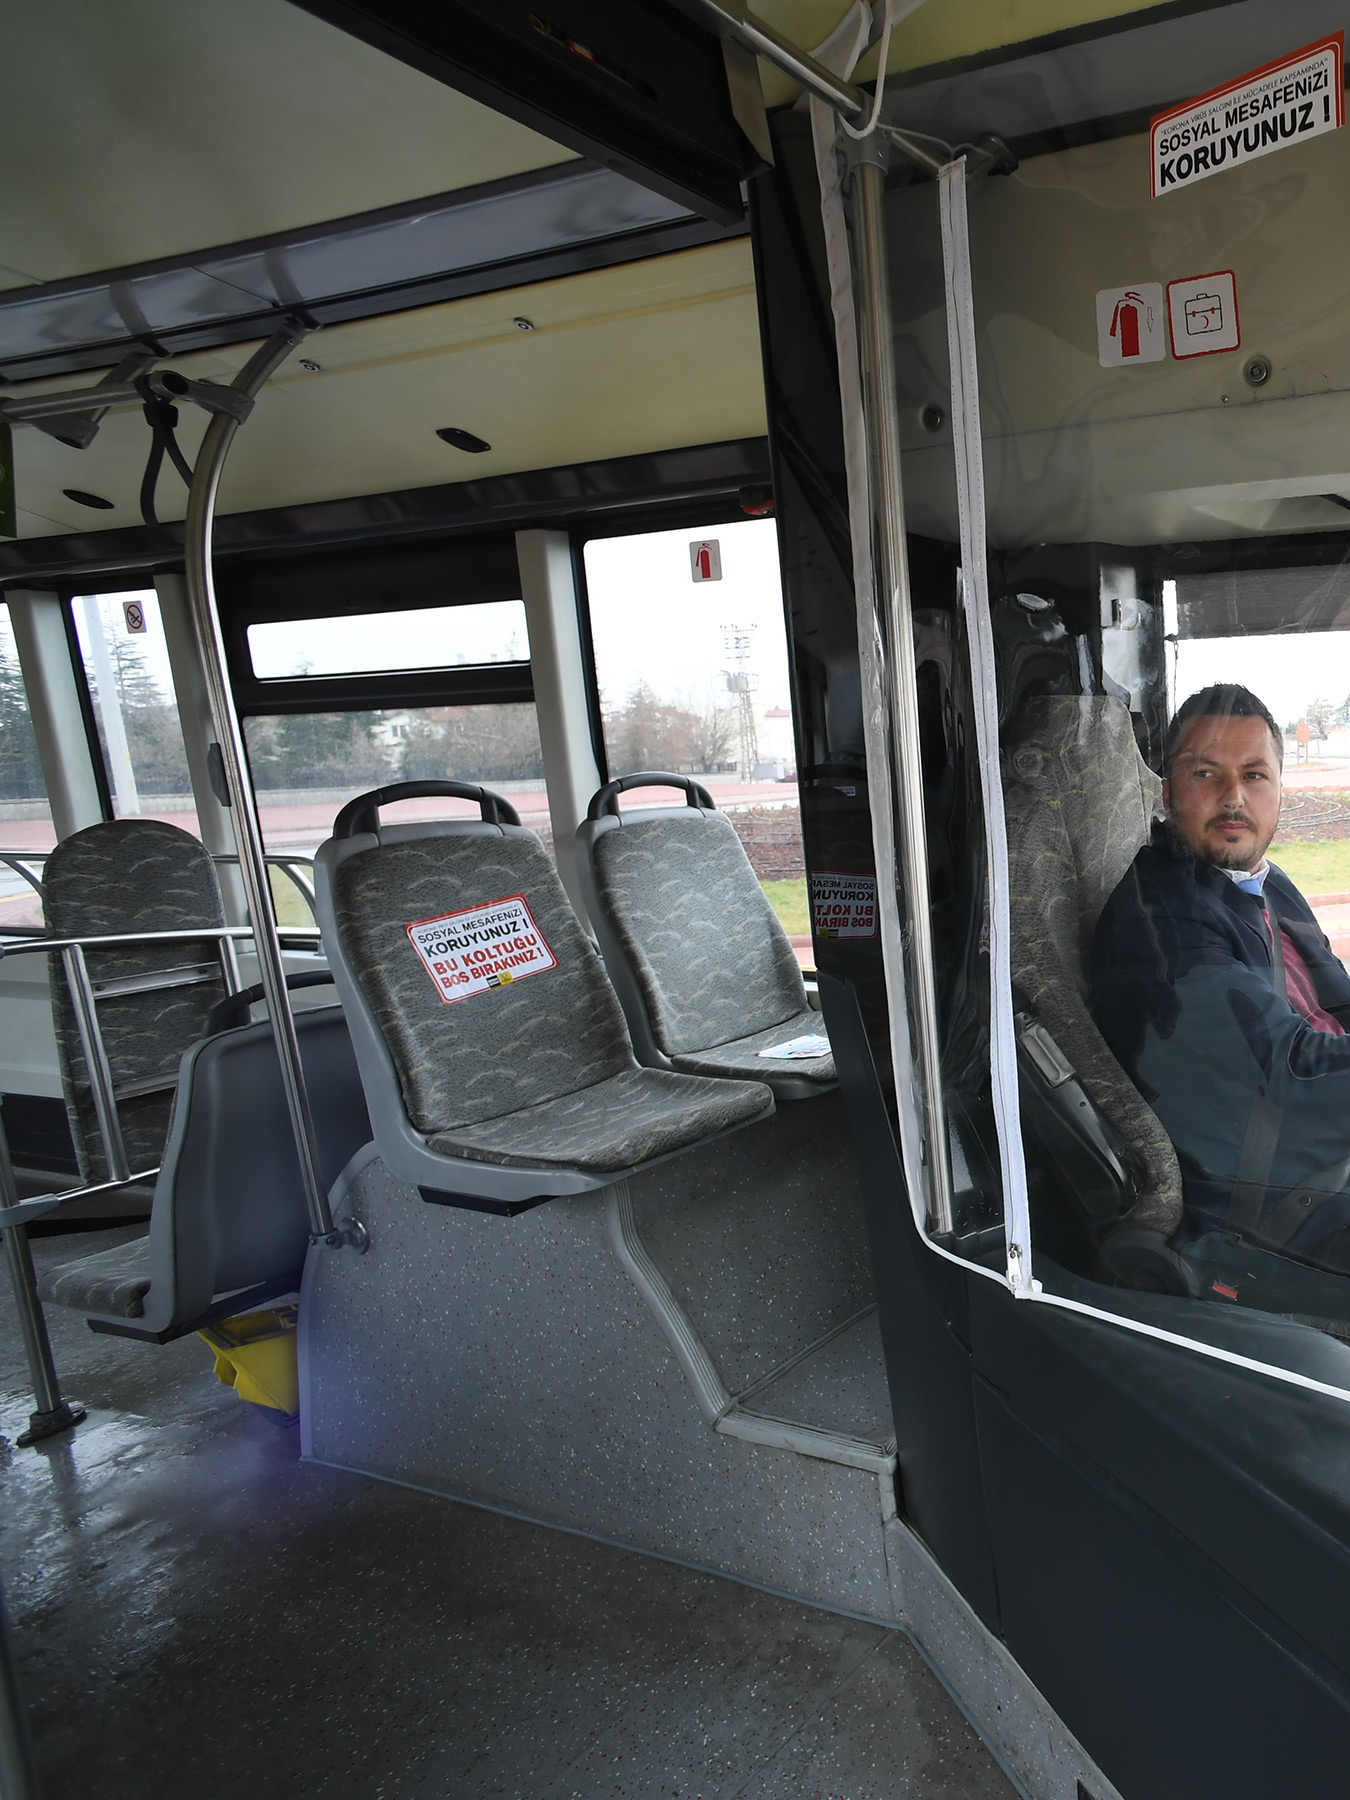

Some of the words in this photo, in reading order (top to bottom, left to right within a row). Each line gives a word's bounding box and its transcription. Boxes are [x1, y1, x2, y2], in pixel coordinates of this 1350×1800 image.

[1159, 117, 1221, 156] SOSYAL
[1160, 101, 1315, 188] KORUYUNUZ
[418, 926, 461, 944] SOSYAL
[424, 920, 521, 958] KORUYUNUZ
[433, 958, 459, 976] BU
[461, 933, 538, 967] KOLTUĞU
[440, 972, 470, 989] BOŞ
[470, 949, 537, 980] BIRAKINIZ
